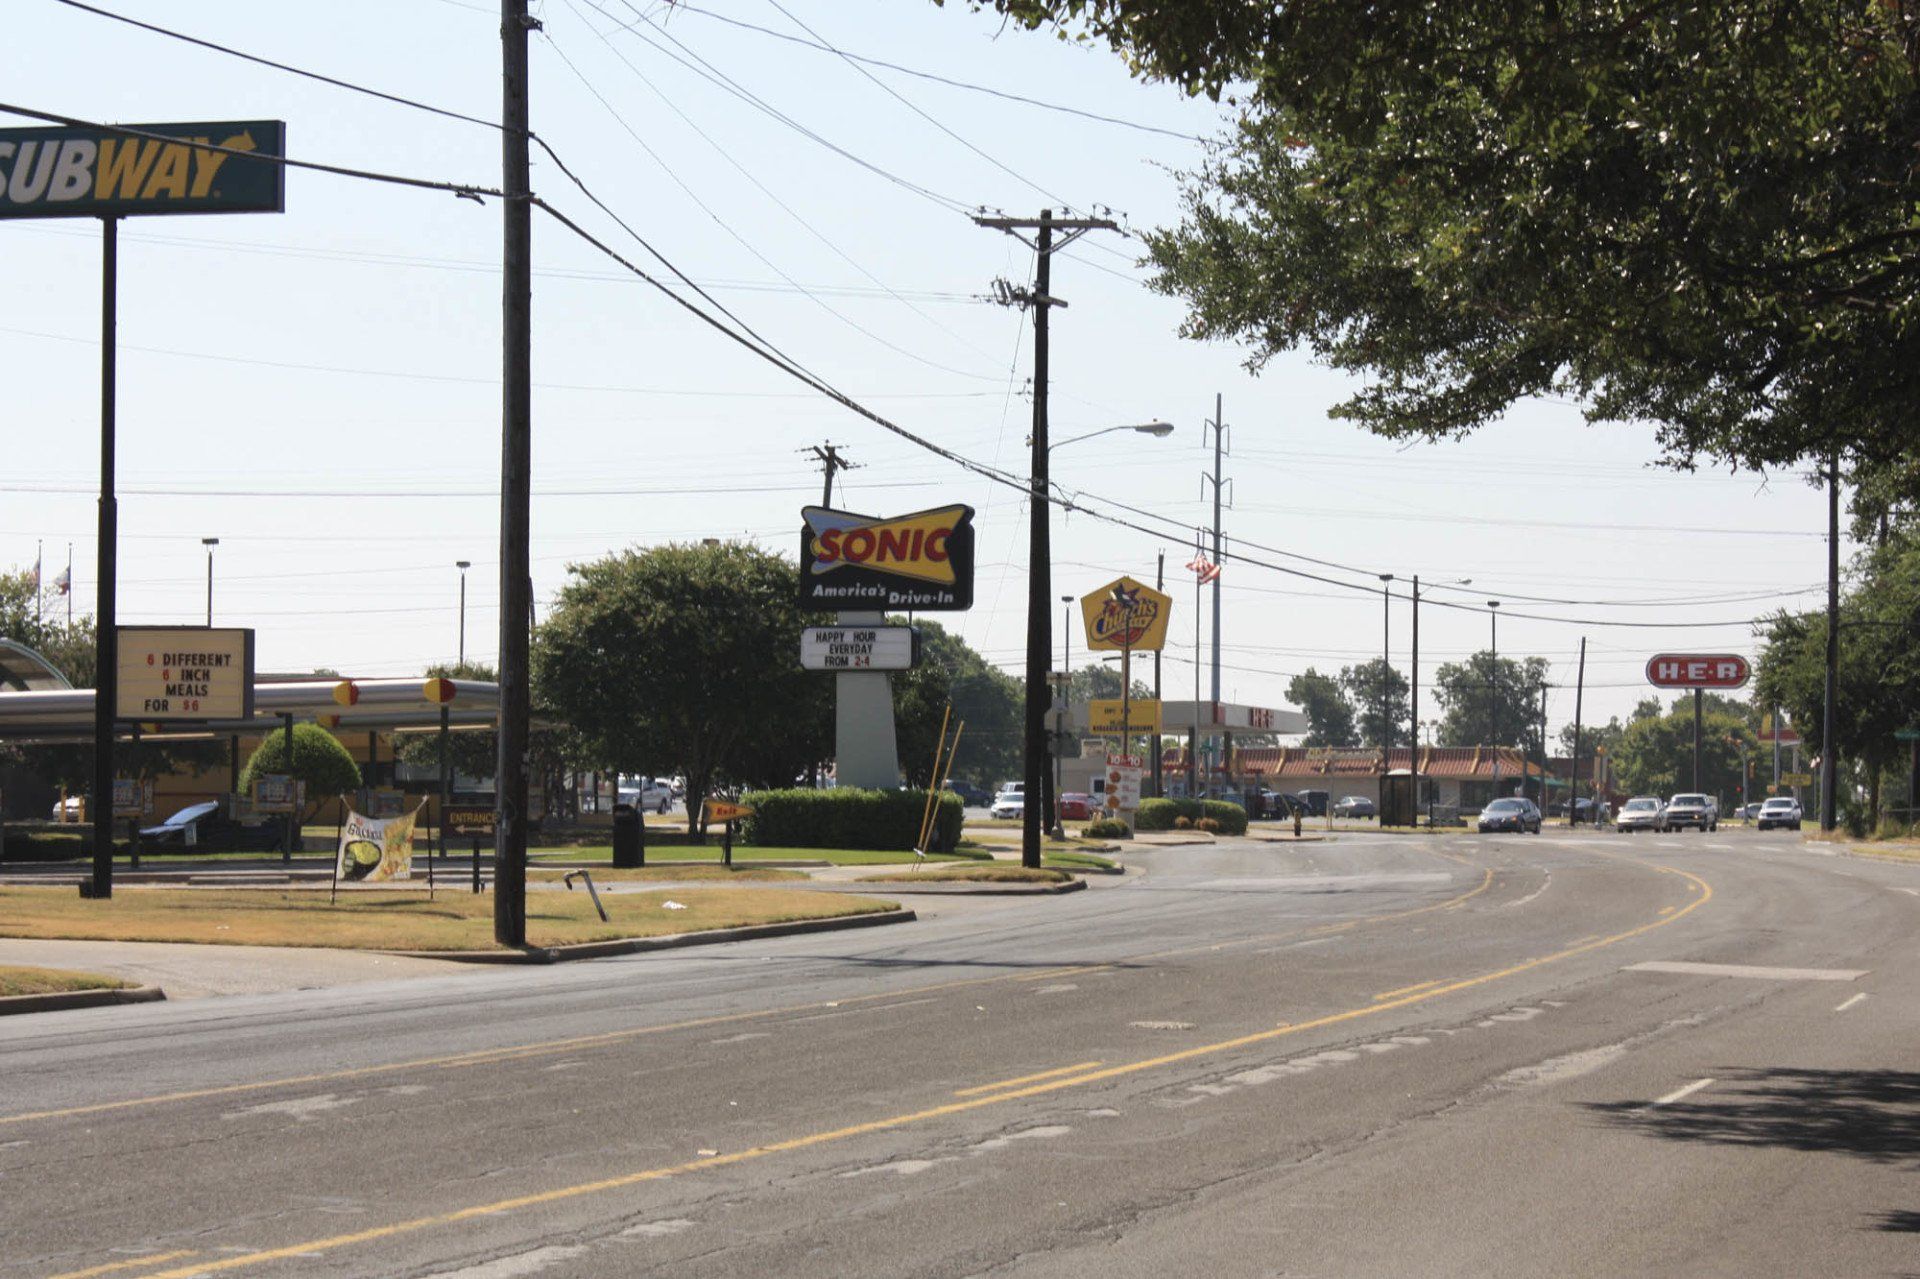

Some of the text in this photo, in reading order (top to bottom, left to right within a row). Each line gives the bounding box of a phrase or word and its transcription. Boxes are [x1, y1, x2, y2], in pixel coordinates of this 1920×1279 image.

[817, 527, 954, 563] SONIC
[812, 583, 954, 604] America's Drive-In
[815, 631, 876, 643] HAPPY HOUR
[829, 644, 873, 655] EVERYDAY
[162, 653, 232, 667] DIFFERENT
[824, 655, 870, 666] FROM 2-4
[181, 668, 211, 682] INCH
[165, 683, 208, 697] MEALS
[144, 699, 169, 712] FOR
